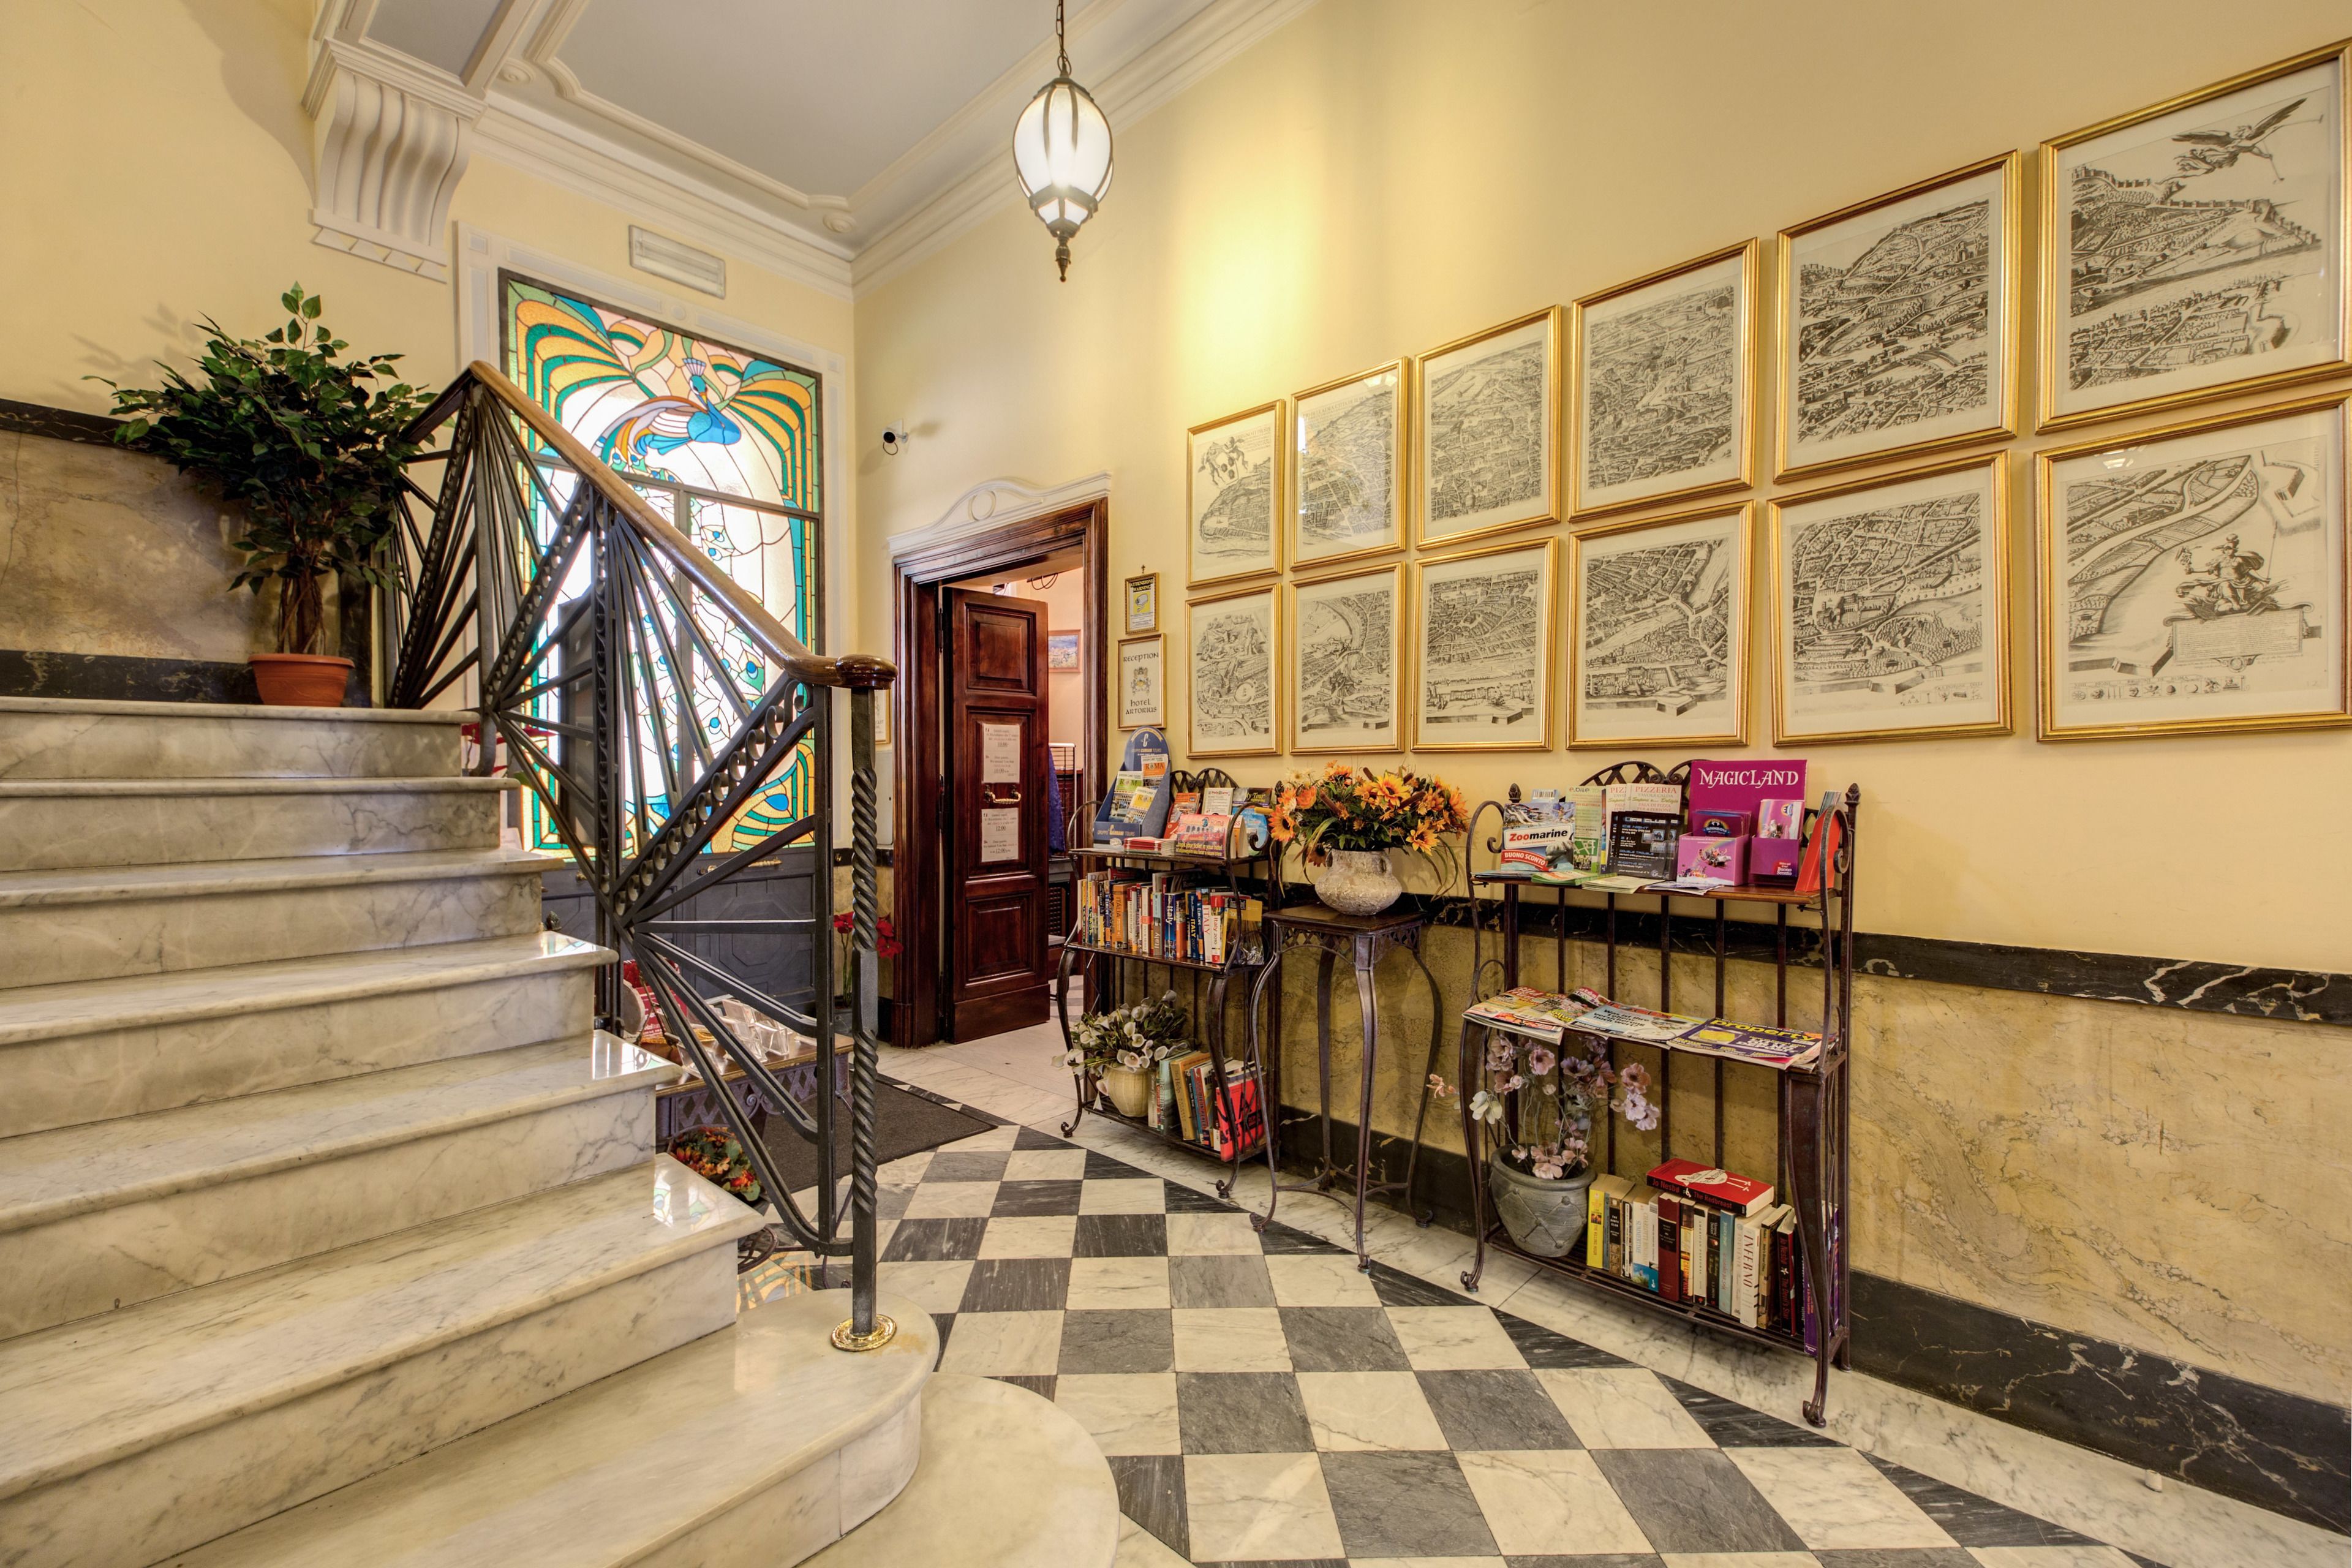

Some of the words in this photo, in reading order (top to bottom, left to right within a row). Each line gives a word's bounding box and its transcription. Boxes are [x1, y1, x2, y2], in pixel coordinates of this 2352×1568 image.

[1131, 578, 1153, 587] ATTENZIONE
[1123, 652, 1159, 662] RECEPTION
[1126, 706, 1157, 715] ARTORIUS
[1698, 768, 1799, 788] MAGICLAND
[1509, 829, 1568, 842] Zoomarine
[1525, 854, 1545, 866] SCONTO
[1710, 1019, 1817, 1041] property
[1660, 1181, 1679, 1193] Nesbø
[1694, 1191, 1703, 1200] The
[1705, 1194, 1733, 1209] Redbreast
[1743, 1234, 1754, 1287] INFERNO
